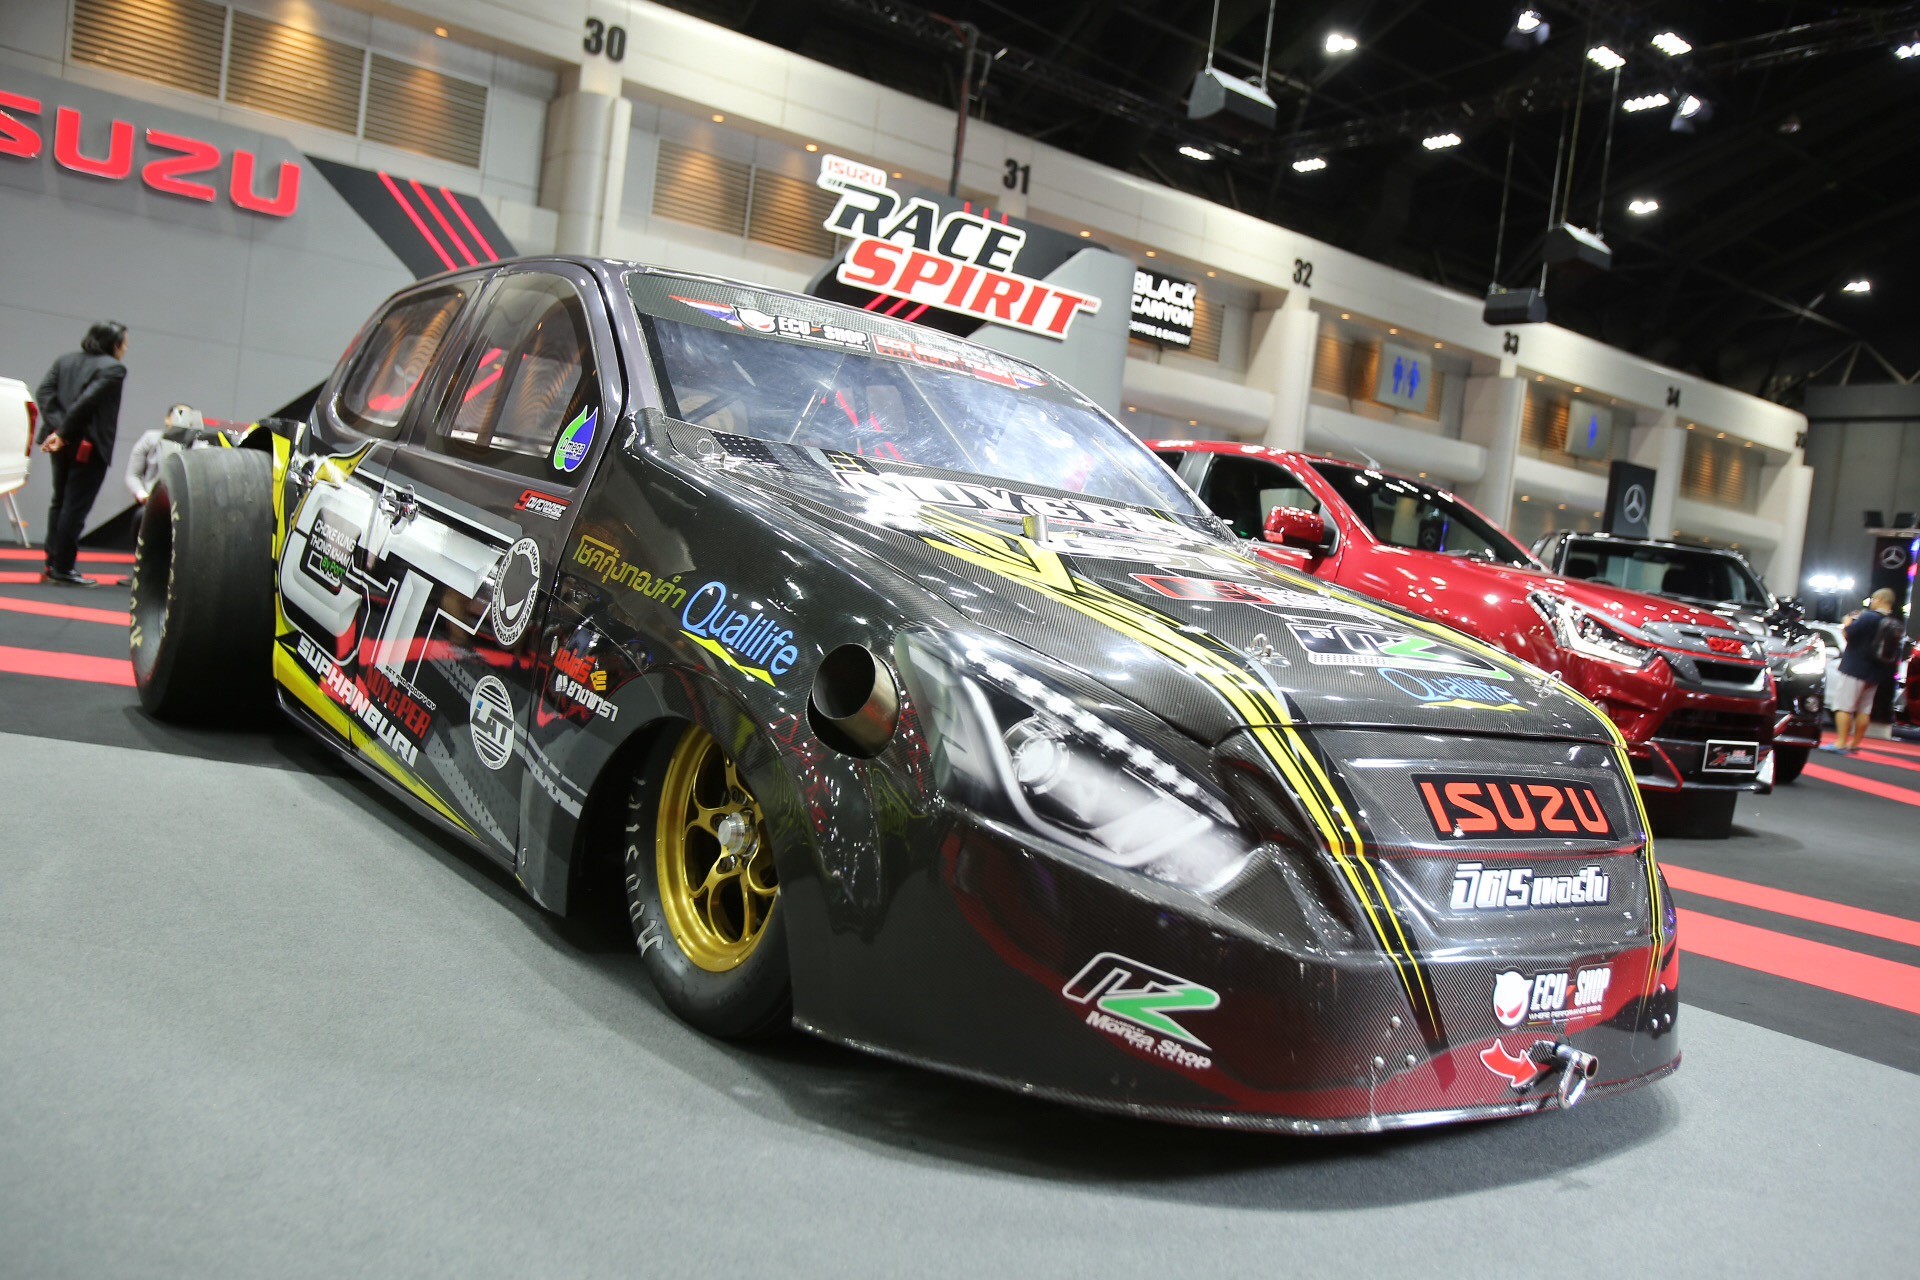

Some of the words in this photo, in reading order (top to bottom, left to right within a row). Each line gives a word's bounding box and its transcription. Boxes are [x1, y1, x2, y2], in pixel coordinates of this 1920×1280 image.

[583, 18, 626, 62] 30
[827, 160, 884, 187] ISUZU
[1003, 159, 1030, 195] 31
[835, 183, 1021, 273] RACE
[845, 240, 1086, 334] SPIRIT
[1132, 270, 1197, 310] BLACK
[1292, 258, 1313, 289] 32
[778, 316, 811, 336] ECU
[823, 324, 868, 345] SHOP
[1130, 293, 1195, 329] CANYON
[310, 534, 332, 557] THONG
[329, 545, 351, 568] KHAM
[314, 519, 338, 544] CHOKE
[336, 533, 357, 553] KUNG
[517, 541, 531, 553] ECU
[529, 546, 539, 573] SHOP
[572, 534, 687, 609] โชคกุ้งทองคำ
[681, 581, 798, 676] Qualilife
[297, 635, 419, 768] SUPHANBURI
[566, 680, 619, 722] ยางพารา
[1378, 667, 1519, 704] Qualilife
[1420, 780, 1610, 835] ISUZU
[1530, 973, 1569, 1012] ECU
[1573, 967, 1612, 1007] SHOP
[1085, 1010, 1155, 1048] Monza
[1157, 1038, 1212, 1070] Shop
